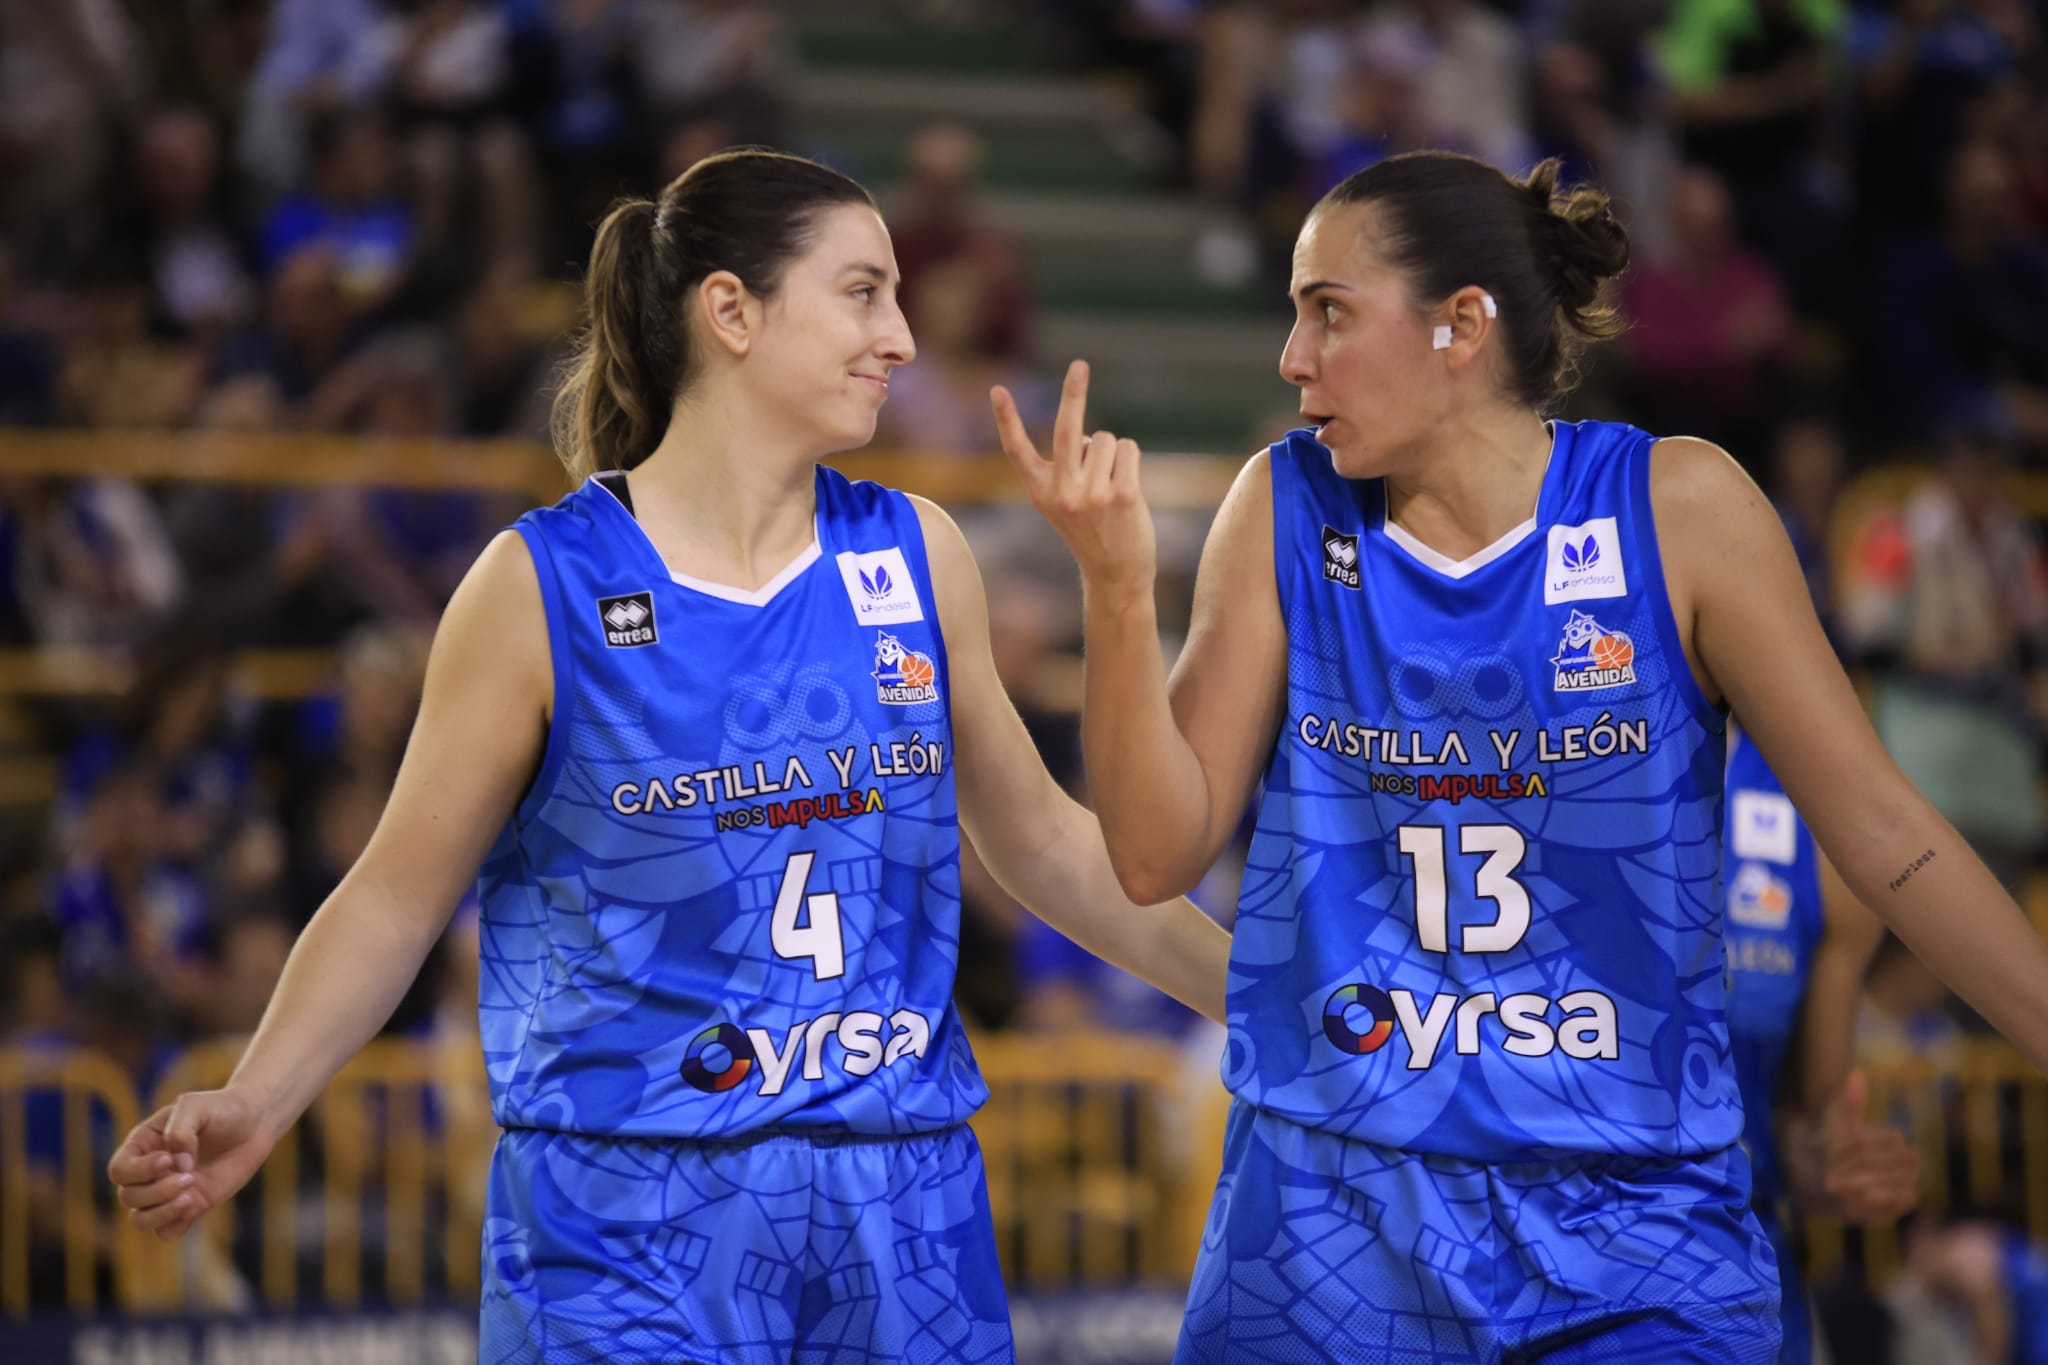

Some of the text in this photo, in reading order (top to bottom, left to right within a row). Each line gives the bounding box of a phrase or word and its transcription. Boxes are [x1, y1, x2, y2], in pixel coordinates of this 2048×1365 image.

[608, 626, 653, 645] errea
[878, 683, 936, 702] AVENIDA
[1557, 666, 1633, 690] AVENIDA
[1298, 711, 1648, 771] CASTILLA Y LEÓN
[611, 730, 943, 815] CASTILLA Y LEÓN
[1370, 773, 1546, 804] NOS IMPULSA
[716, 788, 884, 832] NOS IMPULSA
[1397, 823, 1532, 953] 13
[1889, 849, 1936, 892] fearless
[770, 850, 846, 983] 4
